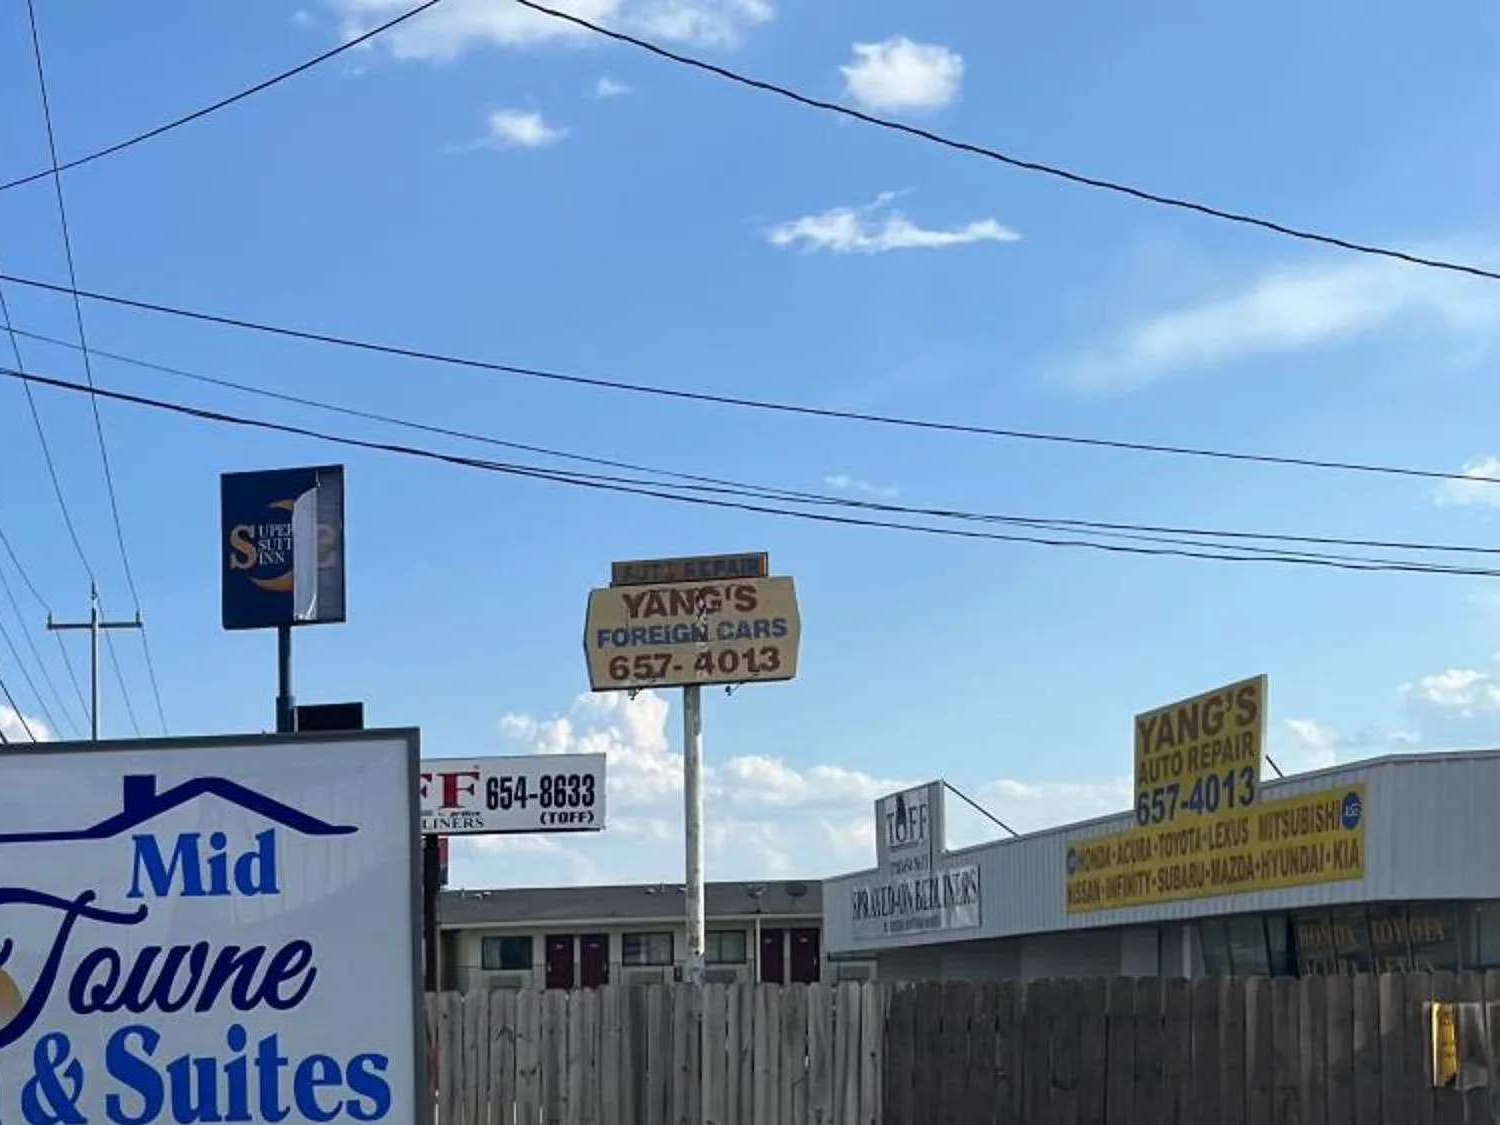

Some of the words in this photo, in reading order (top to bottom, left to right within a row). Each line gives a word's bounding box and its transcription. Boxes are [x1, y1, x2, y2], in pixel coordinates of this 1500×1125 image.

[622, 585, 758, 619] YANG'S
[597, 621, 709, 649] FOREIGN
[716, 617, 788, 641] CARS
[1137, 685, 1258, 755] YANG'S
[1139, 750, 1183, 786] AUTO
[1188, 731, 1255, 774] REPAIR
[486, 774, 596, 811] 654-8633
[1137, 765, 1255, 827] 657-4013
[1208, 815, 1248, 851] LEXUS
[126, 828, 280, 898] Mid
[1157, 861, 1205, 893] SUBARU
[1261, 843, 1324, 880] HYUNDAI
[1332, 837, 1360, 870] KIA
[105, 1023, 392, 1125] Suites
